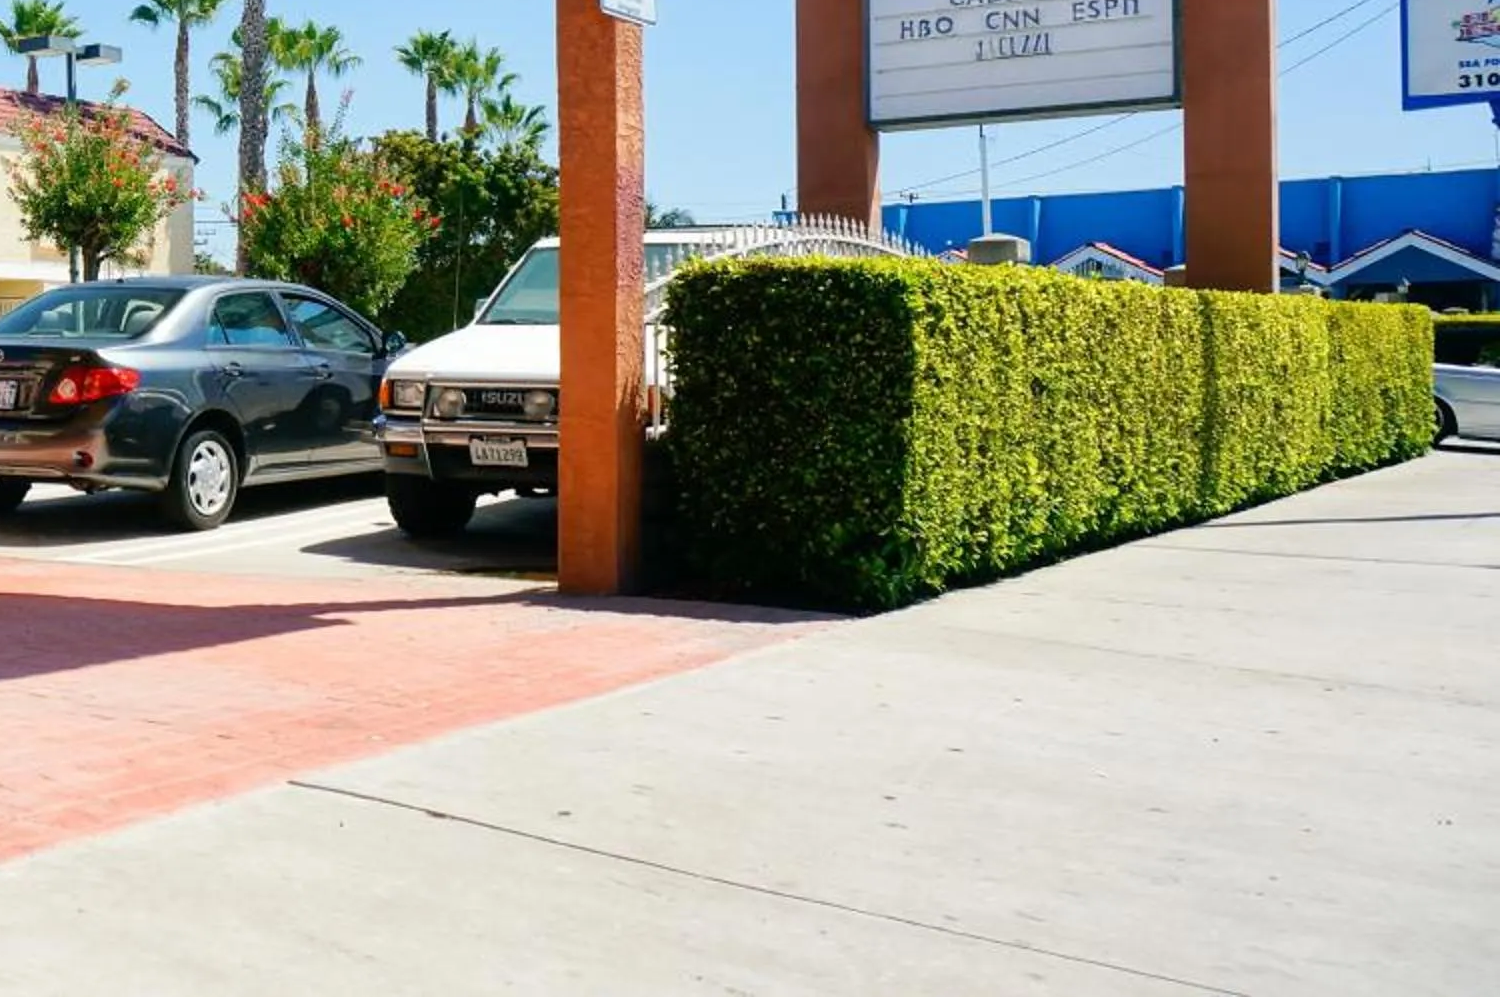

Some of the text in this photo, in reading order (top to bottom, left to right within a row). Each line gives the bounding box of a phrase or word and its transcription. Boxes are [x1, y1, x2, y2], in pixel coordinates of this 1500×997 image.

[900, 16, 954, 40] HBO
[985, 7, 1040, 30] CNN
[1459, 73, 1500, 88] 310
